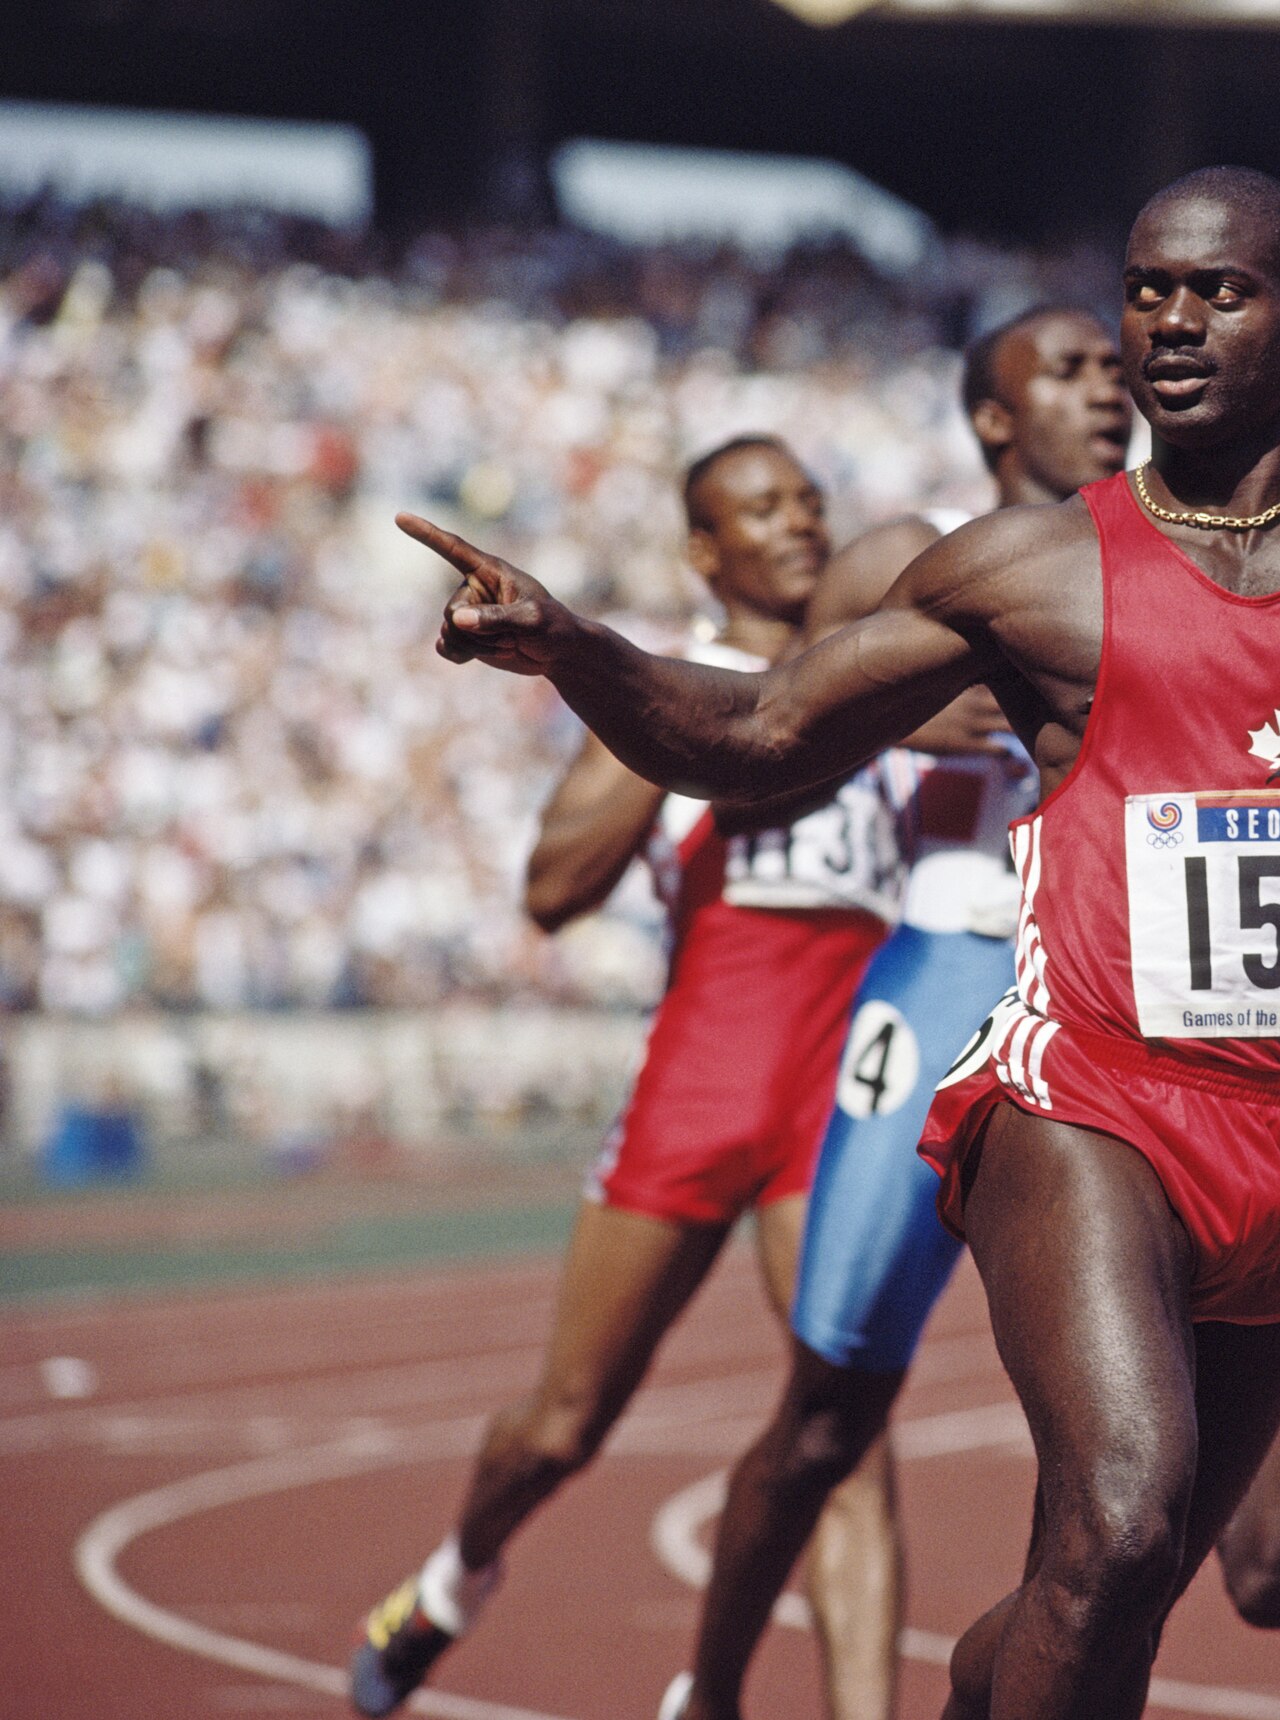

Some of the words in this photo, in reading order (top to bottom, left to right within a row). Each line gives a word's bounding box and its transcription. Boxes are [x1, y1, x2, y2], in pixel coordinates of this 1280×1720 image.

[1182, 1010, 1233, 1028] Games
[1237, 1009, 1251, 1025] of
[1256, 1009, 1277, 1026] the
[854, 1021, 895, 1115] 4
